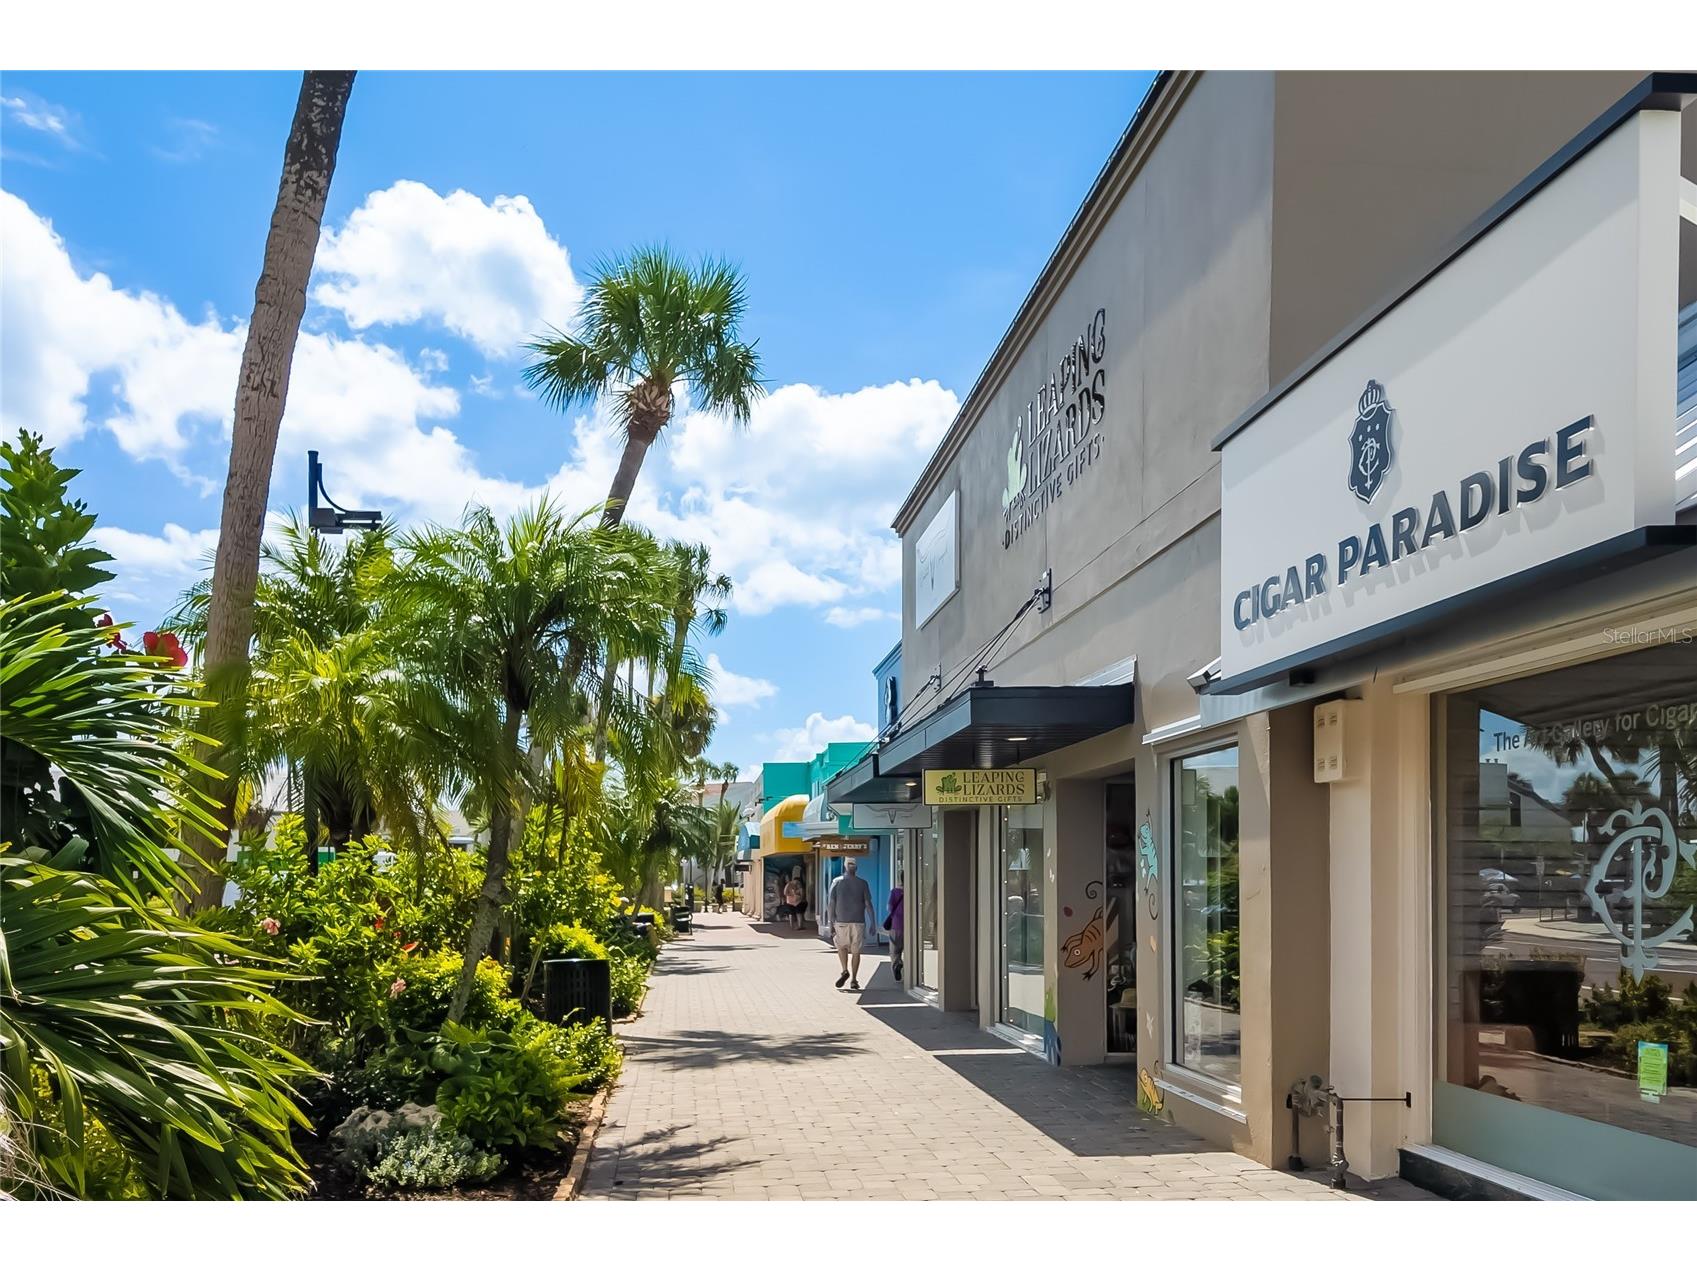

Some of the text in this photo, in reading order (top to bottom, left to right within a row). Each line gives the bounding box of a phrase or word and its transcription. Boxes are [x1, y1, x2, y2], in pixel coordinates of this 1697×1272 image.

[1027, 308, 1105, 446] LEAPING
[1027, 369, 1105, 498] LIZARDS
[1004, 432, 1101, 550] DISTINCTIVE GIFTS
[1233, 413, 1595, 632] CIGAR PARADISE
[963, 771, 1025, 783] LEAPING
[963, 783, 1025, 796] LIZARDS
[1493, 732, 1520, 752] The
[1615, 712, 1641, 732] for
